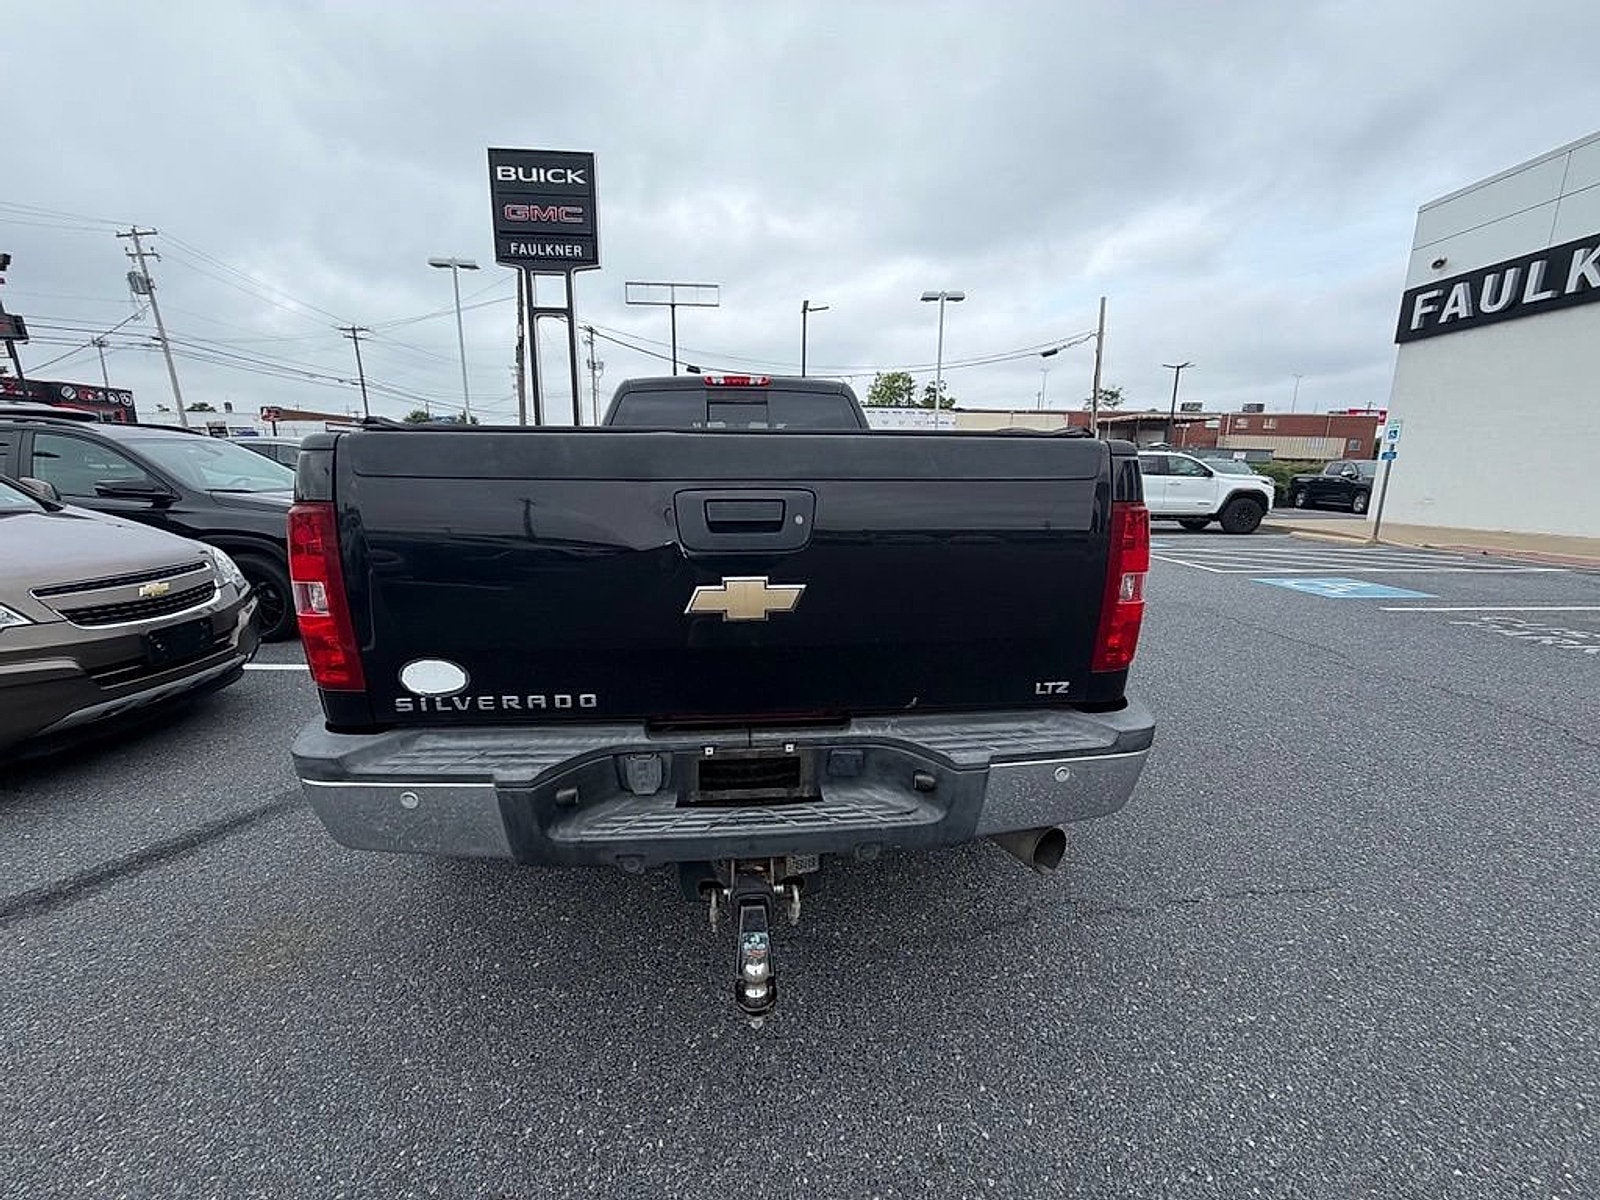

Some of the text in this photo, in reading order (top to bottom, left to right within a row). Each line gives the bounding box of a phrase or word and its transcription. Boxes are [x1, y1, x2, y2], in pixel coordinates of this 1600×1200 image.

[496, 165, 587, 184] BUICK
[504, 204, 583, 223] GMC
[510, 242, 582, 257] FAULKNER
[1410, 245, 1600, 331] FAULK
[1035, 681, 1070, 695] LTZ
[395, 694, 597, 712] SILVERADO
